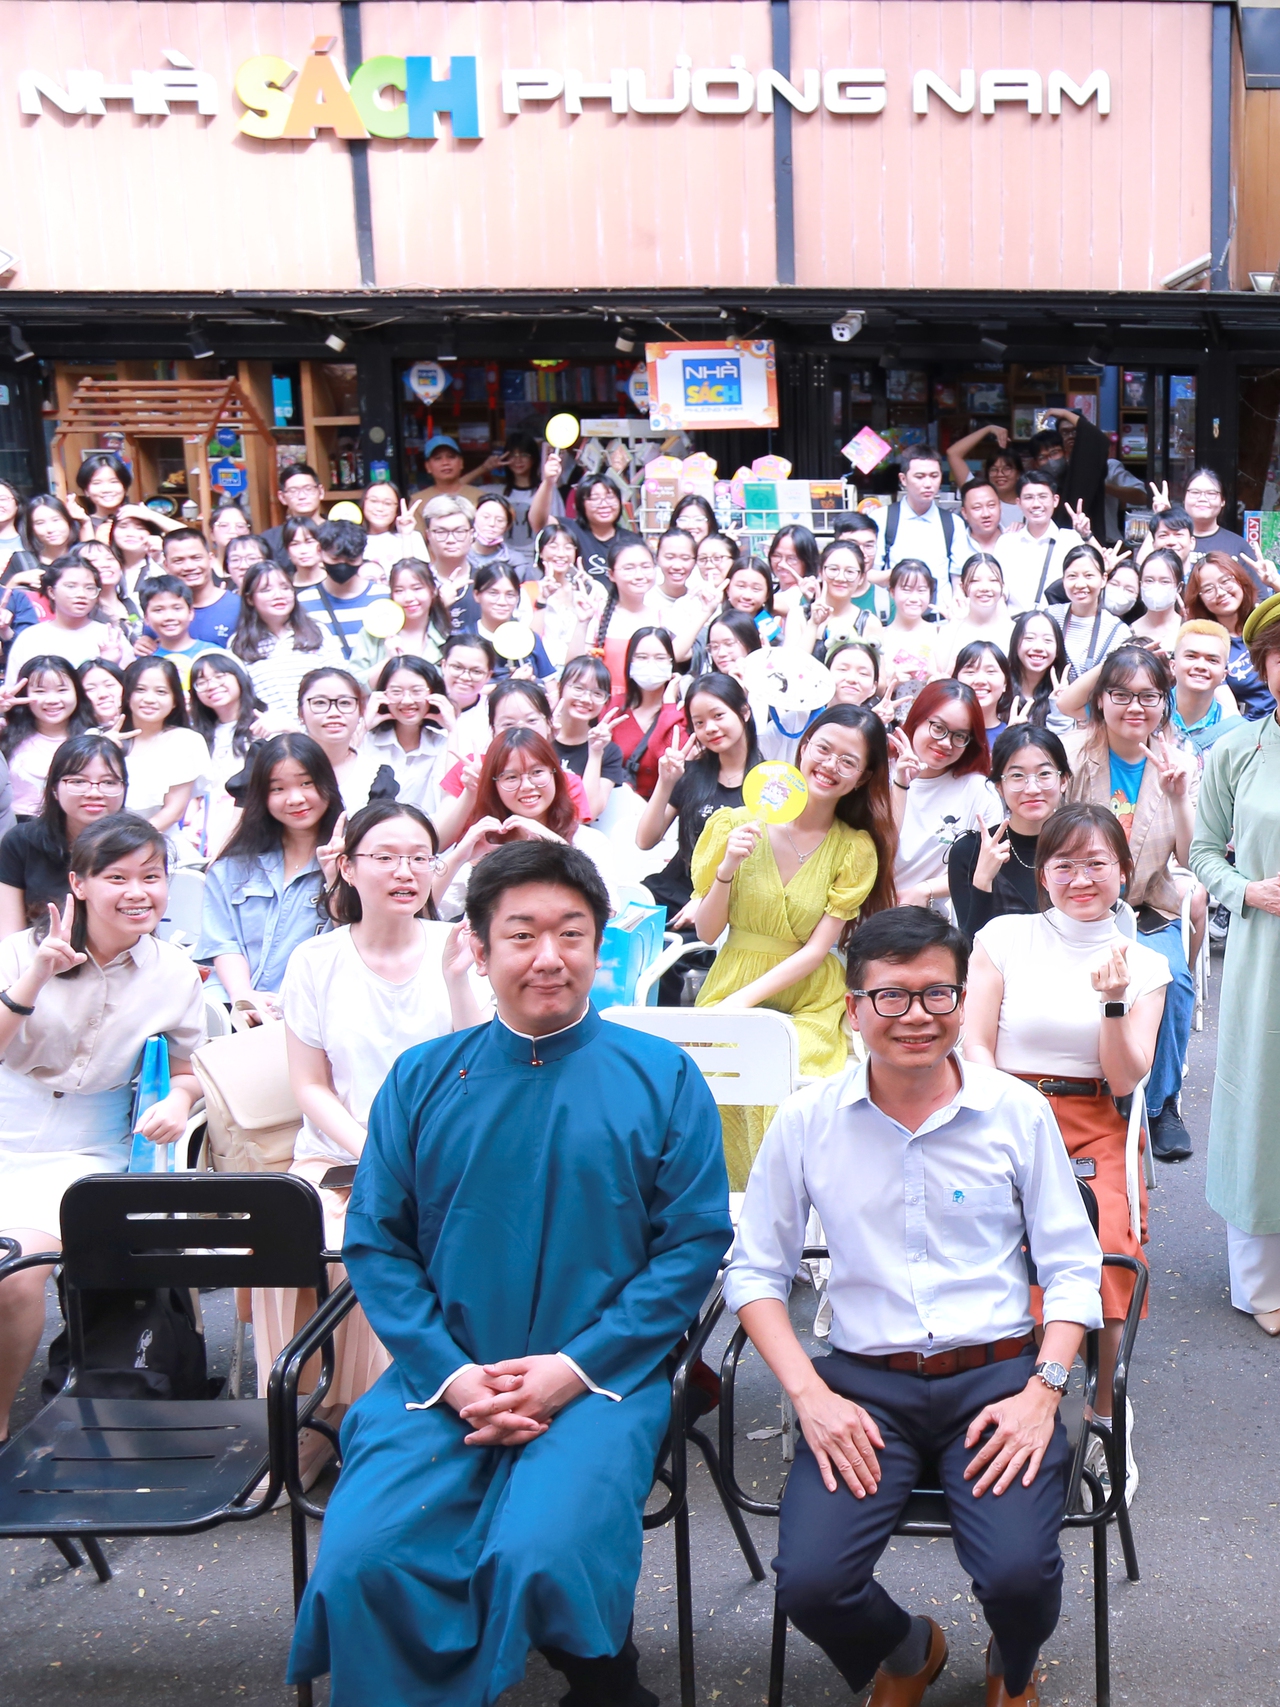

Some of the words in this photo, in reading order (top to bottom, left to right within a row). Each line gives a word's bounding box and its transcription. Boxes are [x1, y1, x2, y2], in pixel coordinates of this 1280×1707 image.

[19, 48, 218, 116] NHÀ
[235, 35, 484, 140] SÁCH
[502, 54, 887, 115] PHƯƠNG
[912, 68, 1111, 116] NAM
[685, 361, 738, 379] NHÀ
[686, 381, 740, 404] SÁCH
